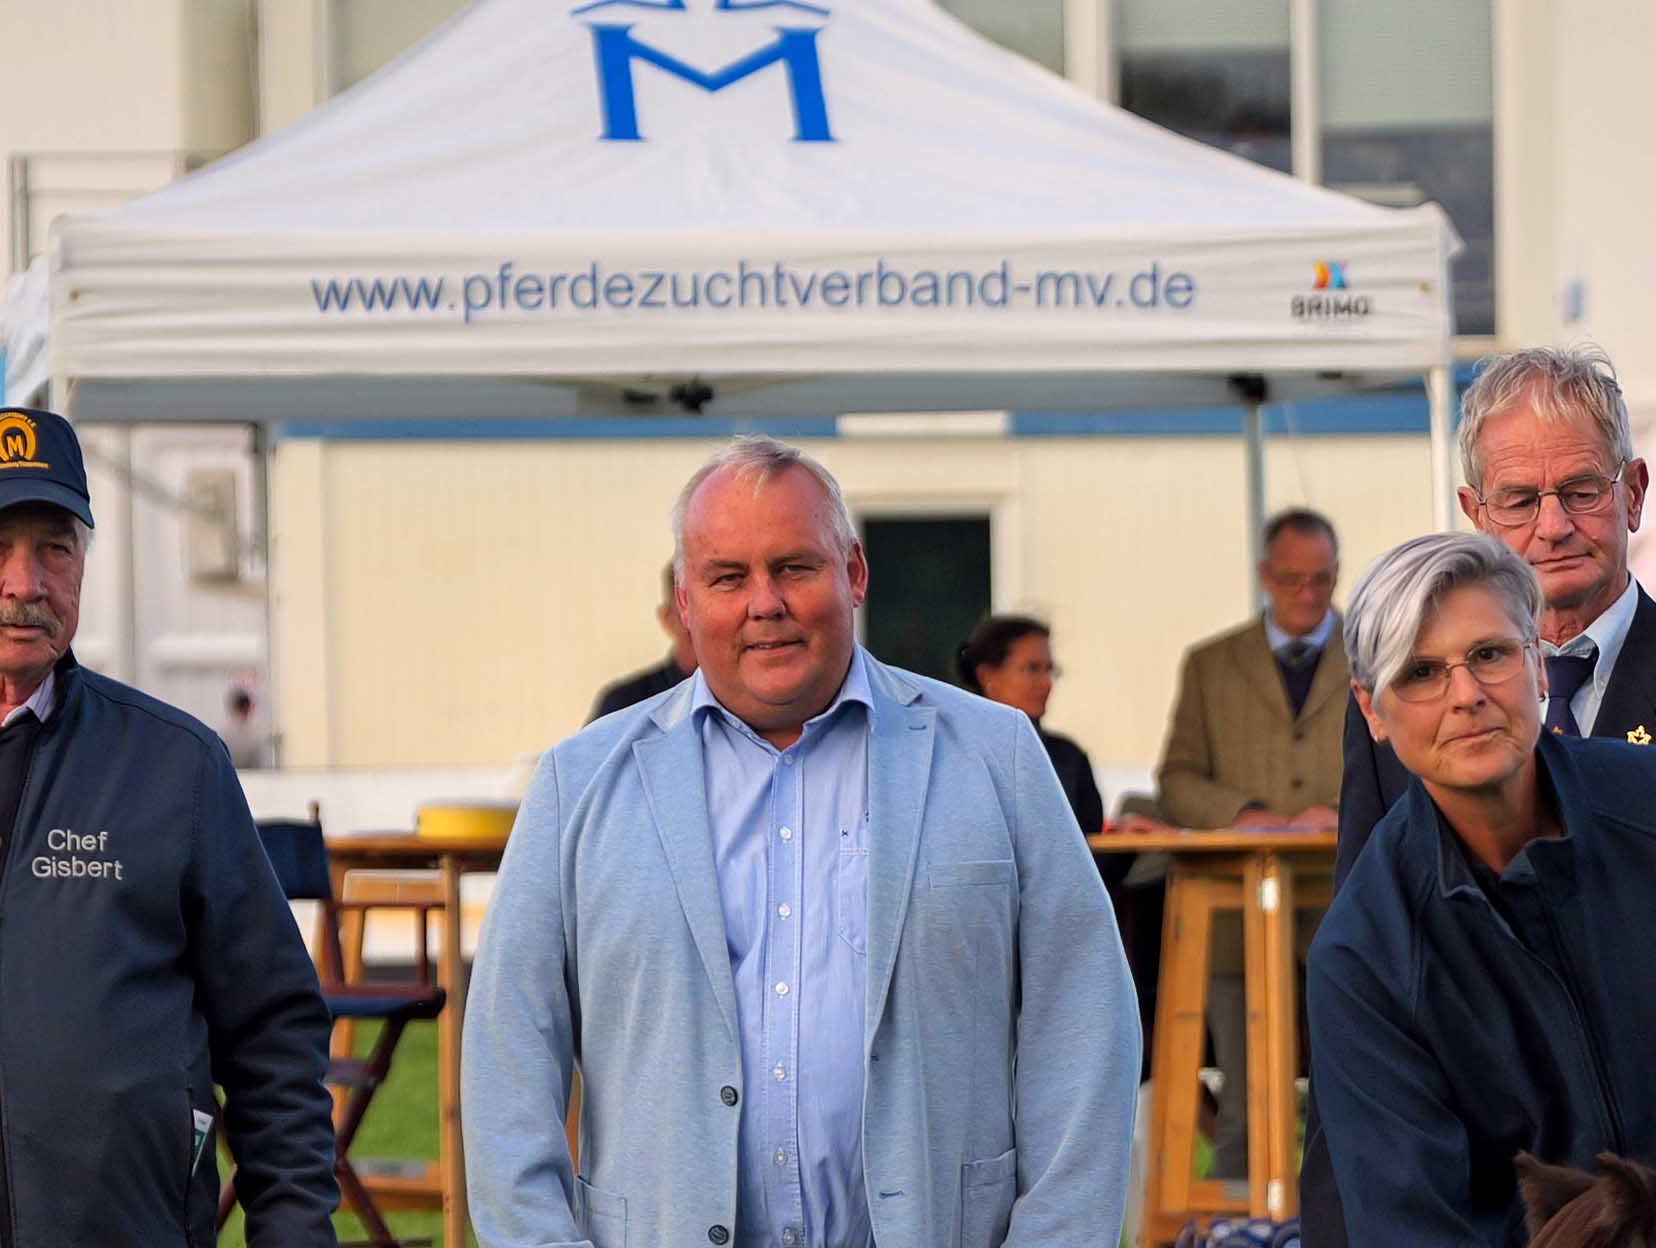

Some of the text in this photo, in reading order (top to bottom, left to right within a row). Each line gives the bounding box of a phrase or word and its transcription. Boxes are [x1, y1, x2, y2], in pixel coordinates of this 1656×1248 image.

[584, 23, 841, 142] M
[310, 257, 1197, 324] www.pferdezuchtverband-mv.de
[47, 829, 108, 851] Chef
[31, 856, 123, 880] Gisbert
